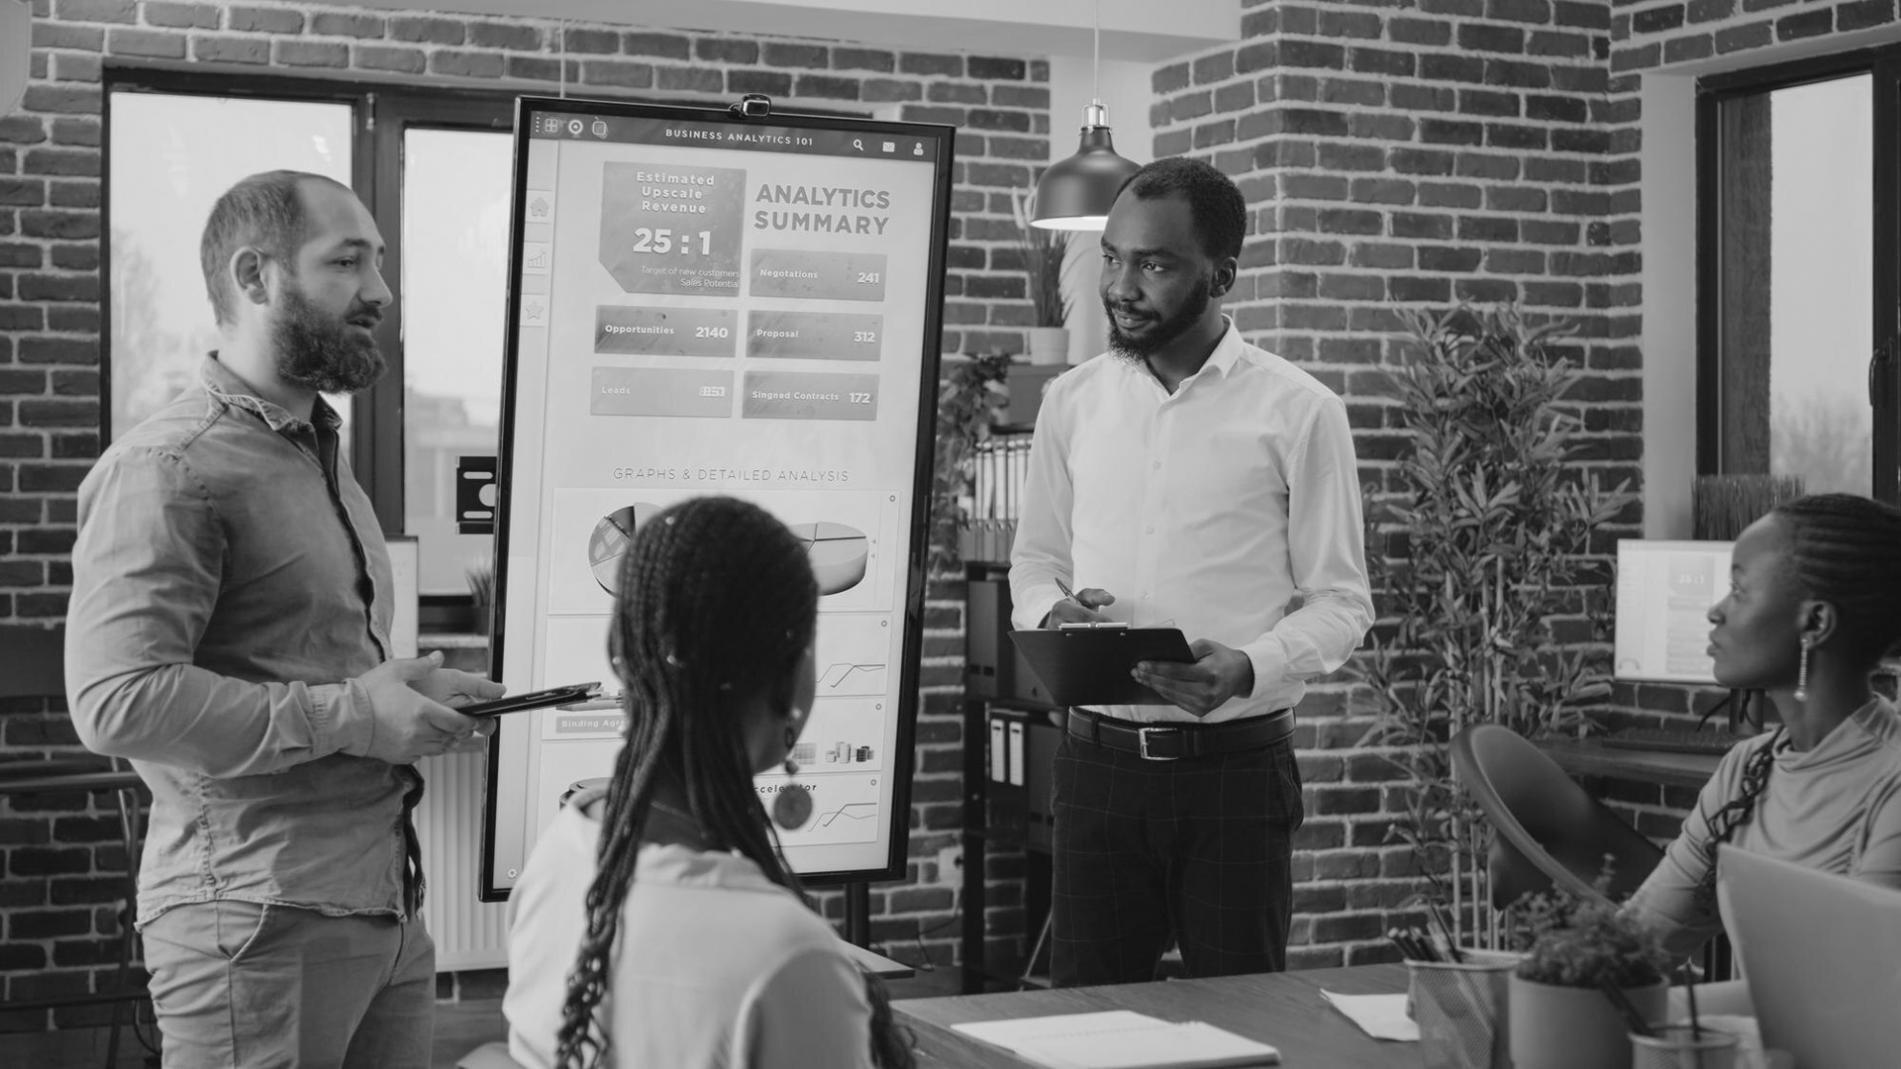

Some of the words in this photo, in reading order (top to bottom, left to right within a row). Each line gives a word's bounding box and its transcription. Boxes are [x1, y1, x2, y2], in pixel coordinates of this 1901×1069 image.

[665, 128, 723, 141] BUSINESS
[727, 132, 791, 145] ANALYTICS
[796, 136, 813, 146] 101
[636, 171, 715, 186] Estimated
[641, 186, 703, 199] Upscale
[755, 183, 890, 209] ANALYTICS
[641, 200, 706, 214] Revenue
[753, 210, 889, 236] SUMMARY
[632, 227, 672, 254] 25
[698, 230, 711, 255] 1
[759, 269, 818, 279] Negotations
[857, 271, 880, 283] 241
[604, 324, 675, 335] Opportunities
[695, 326, 729, 338] 2140
[756, 328, 800, 339] Proposal
[853, 331, 876, 343] 312
[601, 385, 631, 394] Leads
[793, 391, 840, 401] Contracts
[848, 392, 871, 404] 172
[612, 467, 676, 480] GRAPHS
[682, 470, 691, 480] &
[697, 468, 772, 481] DETAILED
[777, 469, 849, 482] ANALYSIS
